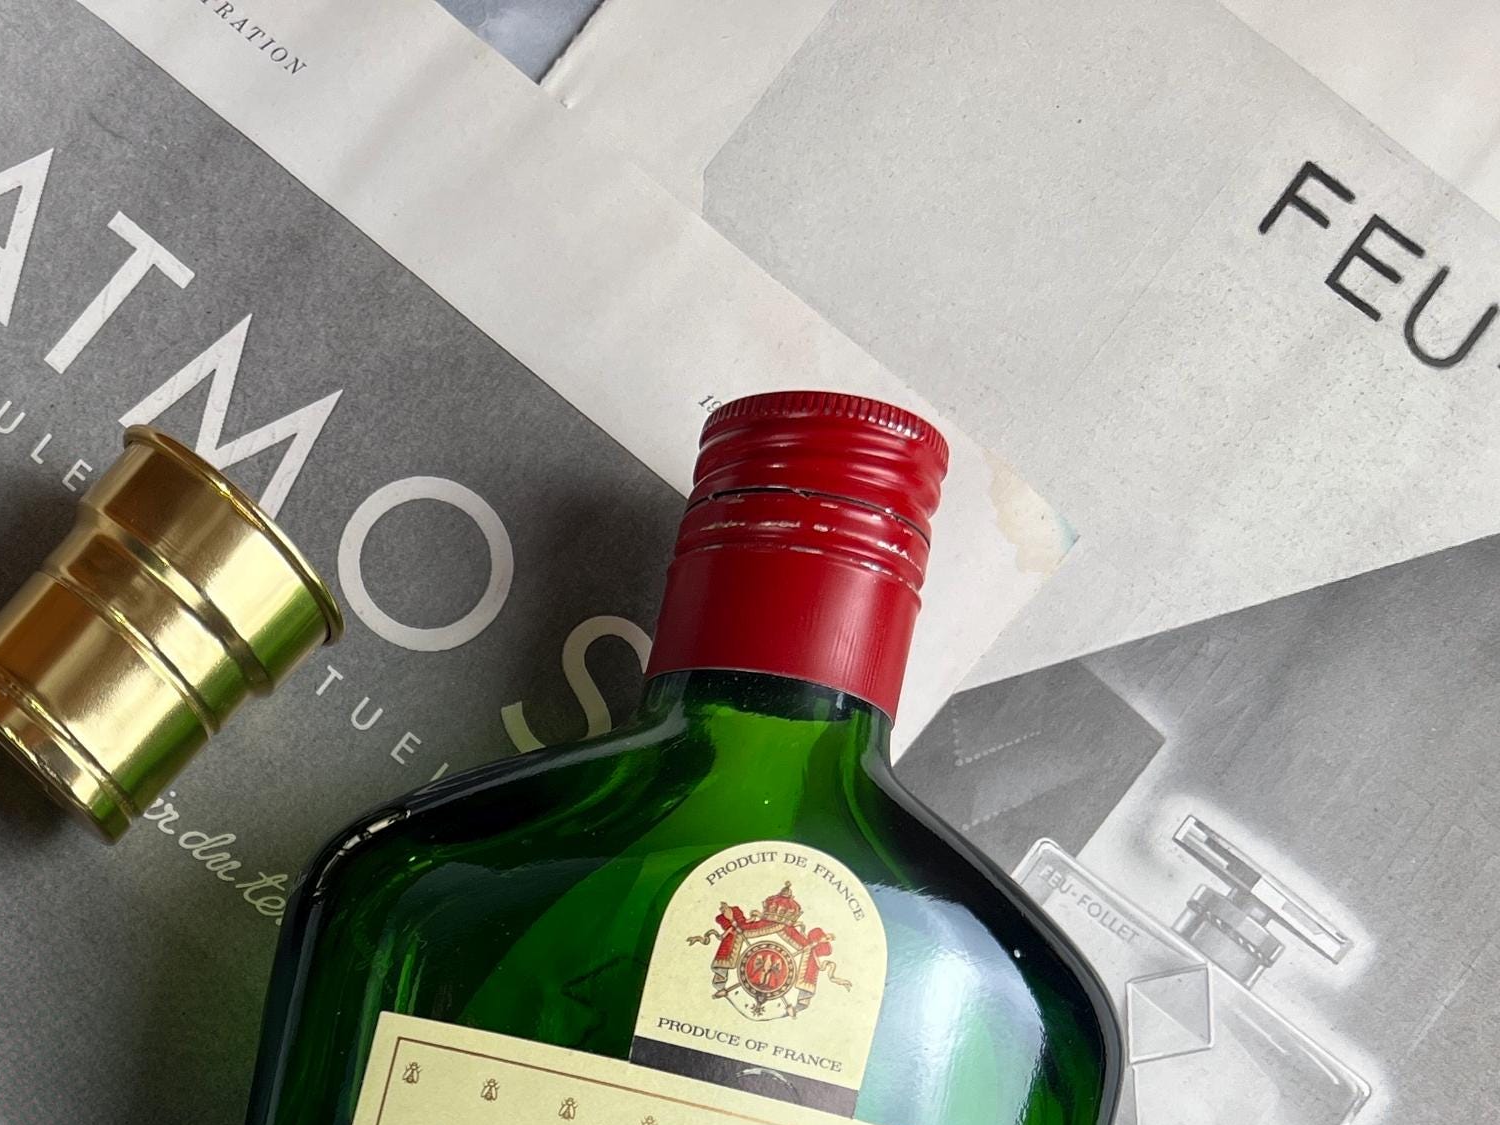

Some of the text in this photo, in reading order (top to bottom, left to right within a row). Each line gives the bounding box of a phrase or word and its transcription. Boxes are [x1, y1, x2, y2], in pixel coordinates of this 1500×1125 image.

[706, 852, 865, 922] PRODUIT DE FRANCE
[1040, 865, 1139, 944] FEU-FOLLET
[657, 1017, 843, 1073] PRODUCE OF FRANCE
